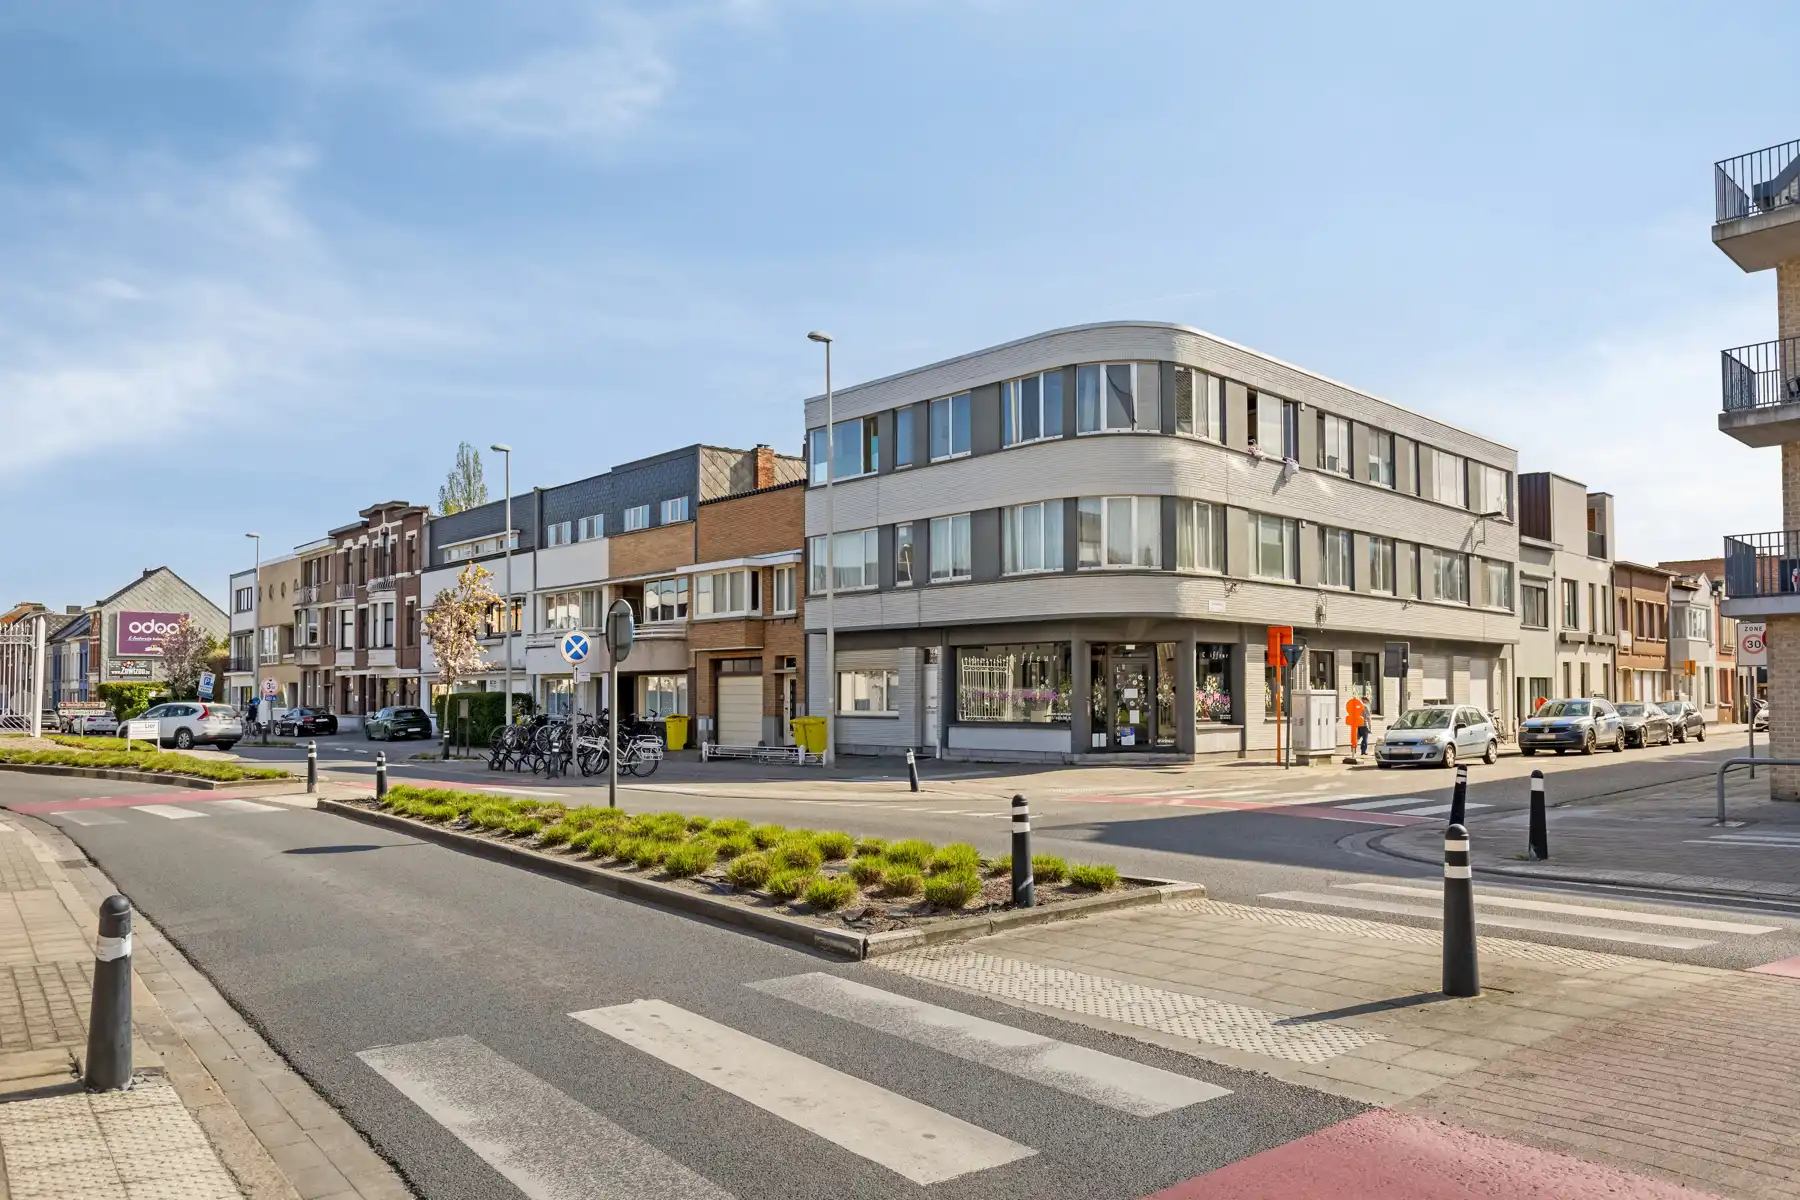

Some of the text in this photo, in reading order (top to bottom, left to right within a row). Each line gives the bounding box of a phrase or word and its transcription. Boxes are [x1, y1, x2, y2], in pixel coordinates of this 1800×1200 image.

[1747, 640, 1761, 648] 30
[997, 652, 1058, 666] Ciffeur
[1202, 650, 1228, 660] Ciffeur
